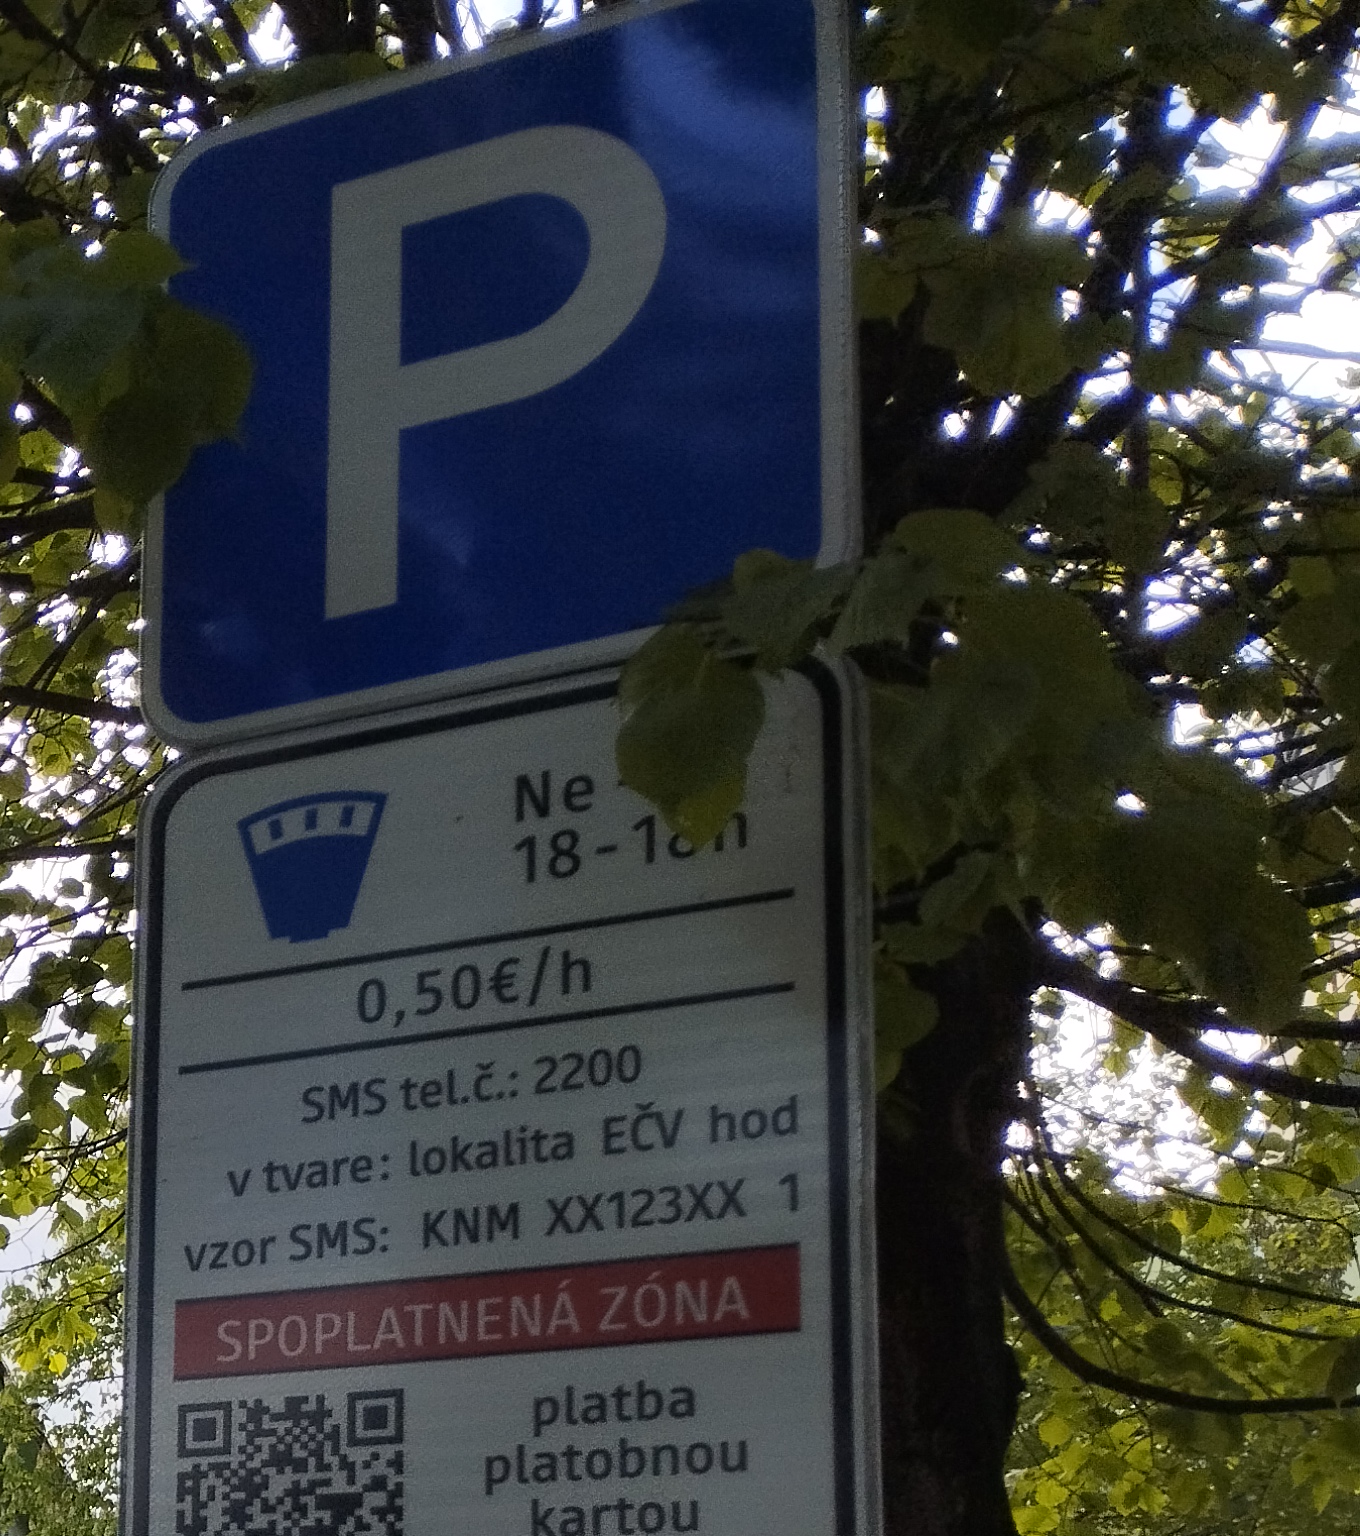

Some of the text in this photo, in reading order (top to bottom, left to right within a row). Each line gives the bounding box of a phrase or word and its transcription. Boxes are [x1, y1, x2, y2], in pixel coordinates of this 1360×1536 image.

[325, 124, 667, 620] P
[515, 769, 595, 822] Ne
[357, 946, 591, 1028] 0,50€/h
[301, 1078, 387, 1123] SMS
[534, 1045, 641, 1094] 2200
[227, 1094, 798, 1197] v tvare: lokalita EČV hod
[184, 1172, 799, 1271] vzor SMS: KNM XX123XX 1
[216, 1269, 750, 1362] SPOPLATNENÁ ZÓNA
[533, 1379, 696, 1437] platba
[485, 1437, 748, 1495] platobnou
